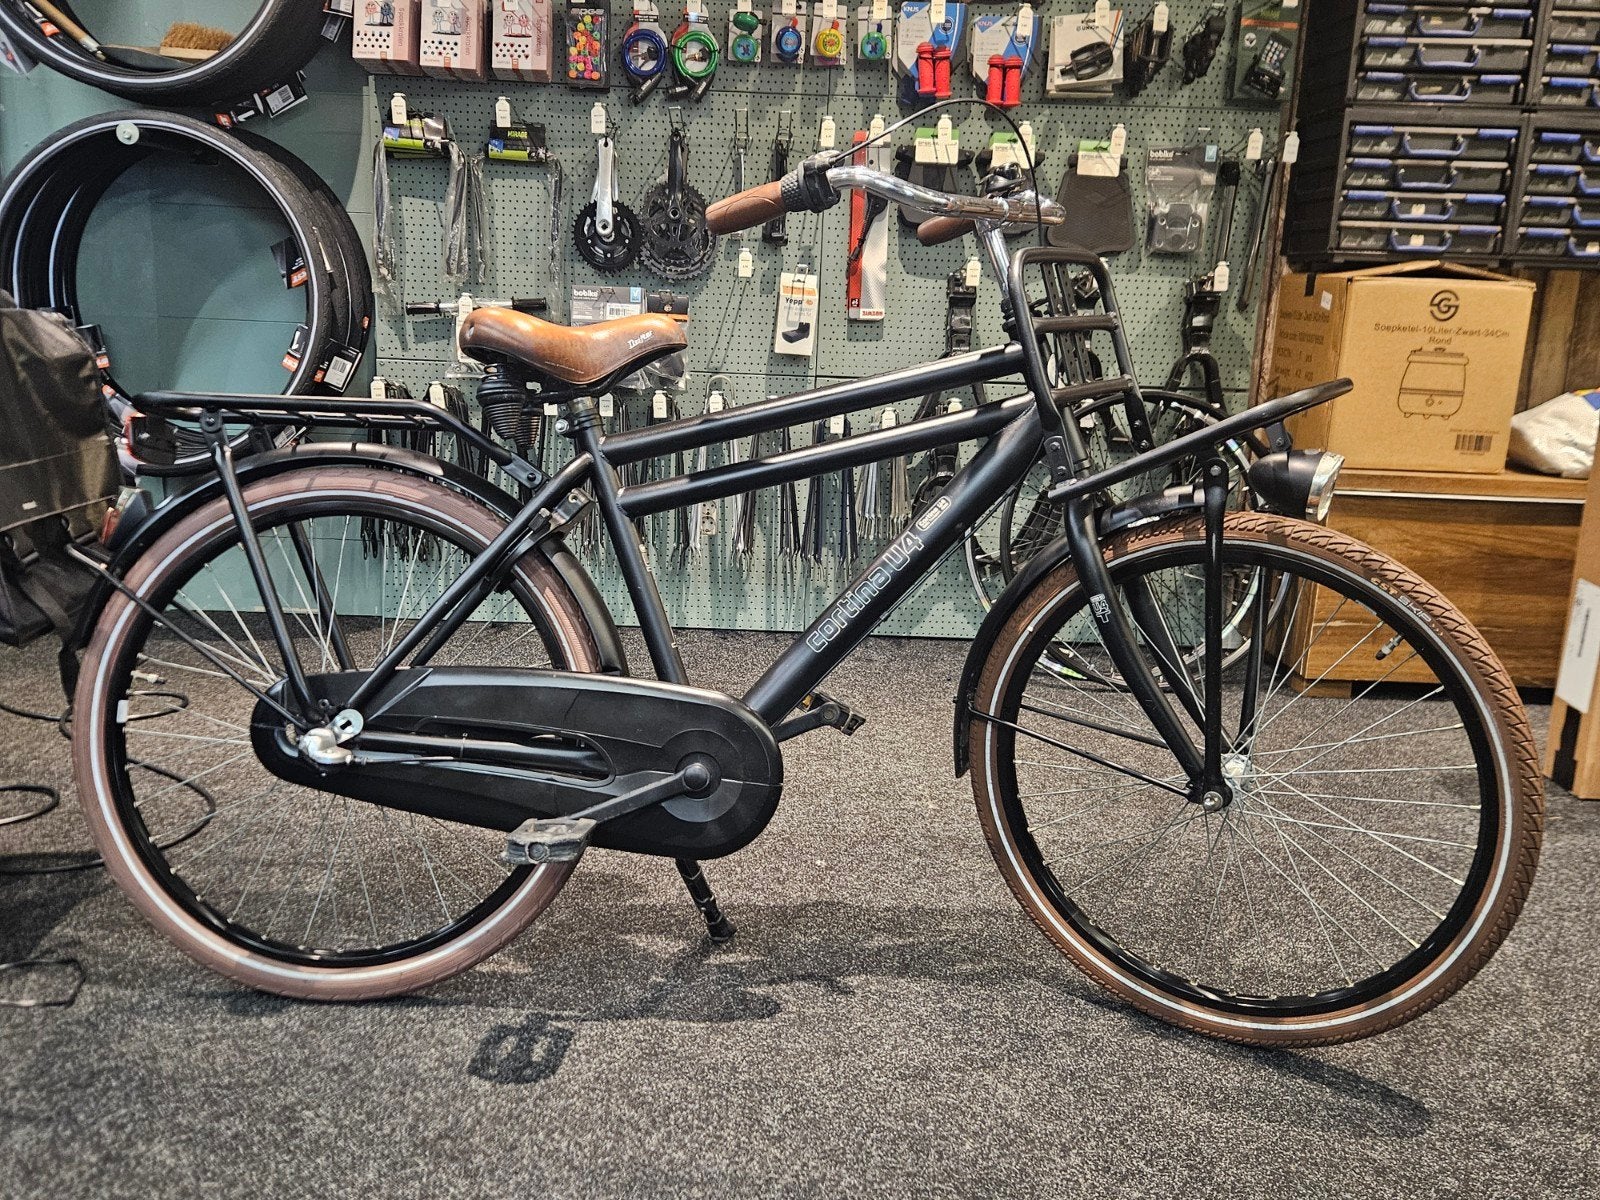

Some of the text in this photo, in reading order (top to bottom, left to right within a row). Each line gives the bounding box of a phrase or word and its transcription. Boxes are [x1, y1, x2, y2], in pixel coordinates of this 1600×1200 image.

[507, 130, 528, 139] MIRAGE
[573, 288, 599, 298] bobike
[785, 297, 803, 306] Yepp
[806, 530, 925, 653] cortina U4
[1398, 595, 1432, 622] SKIP
